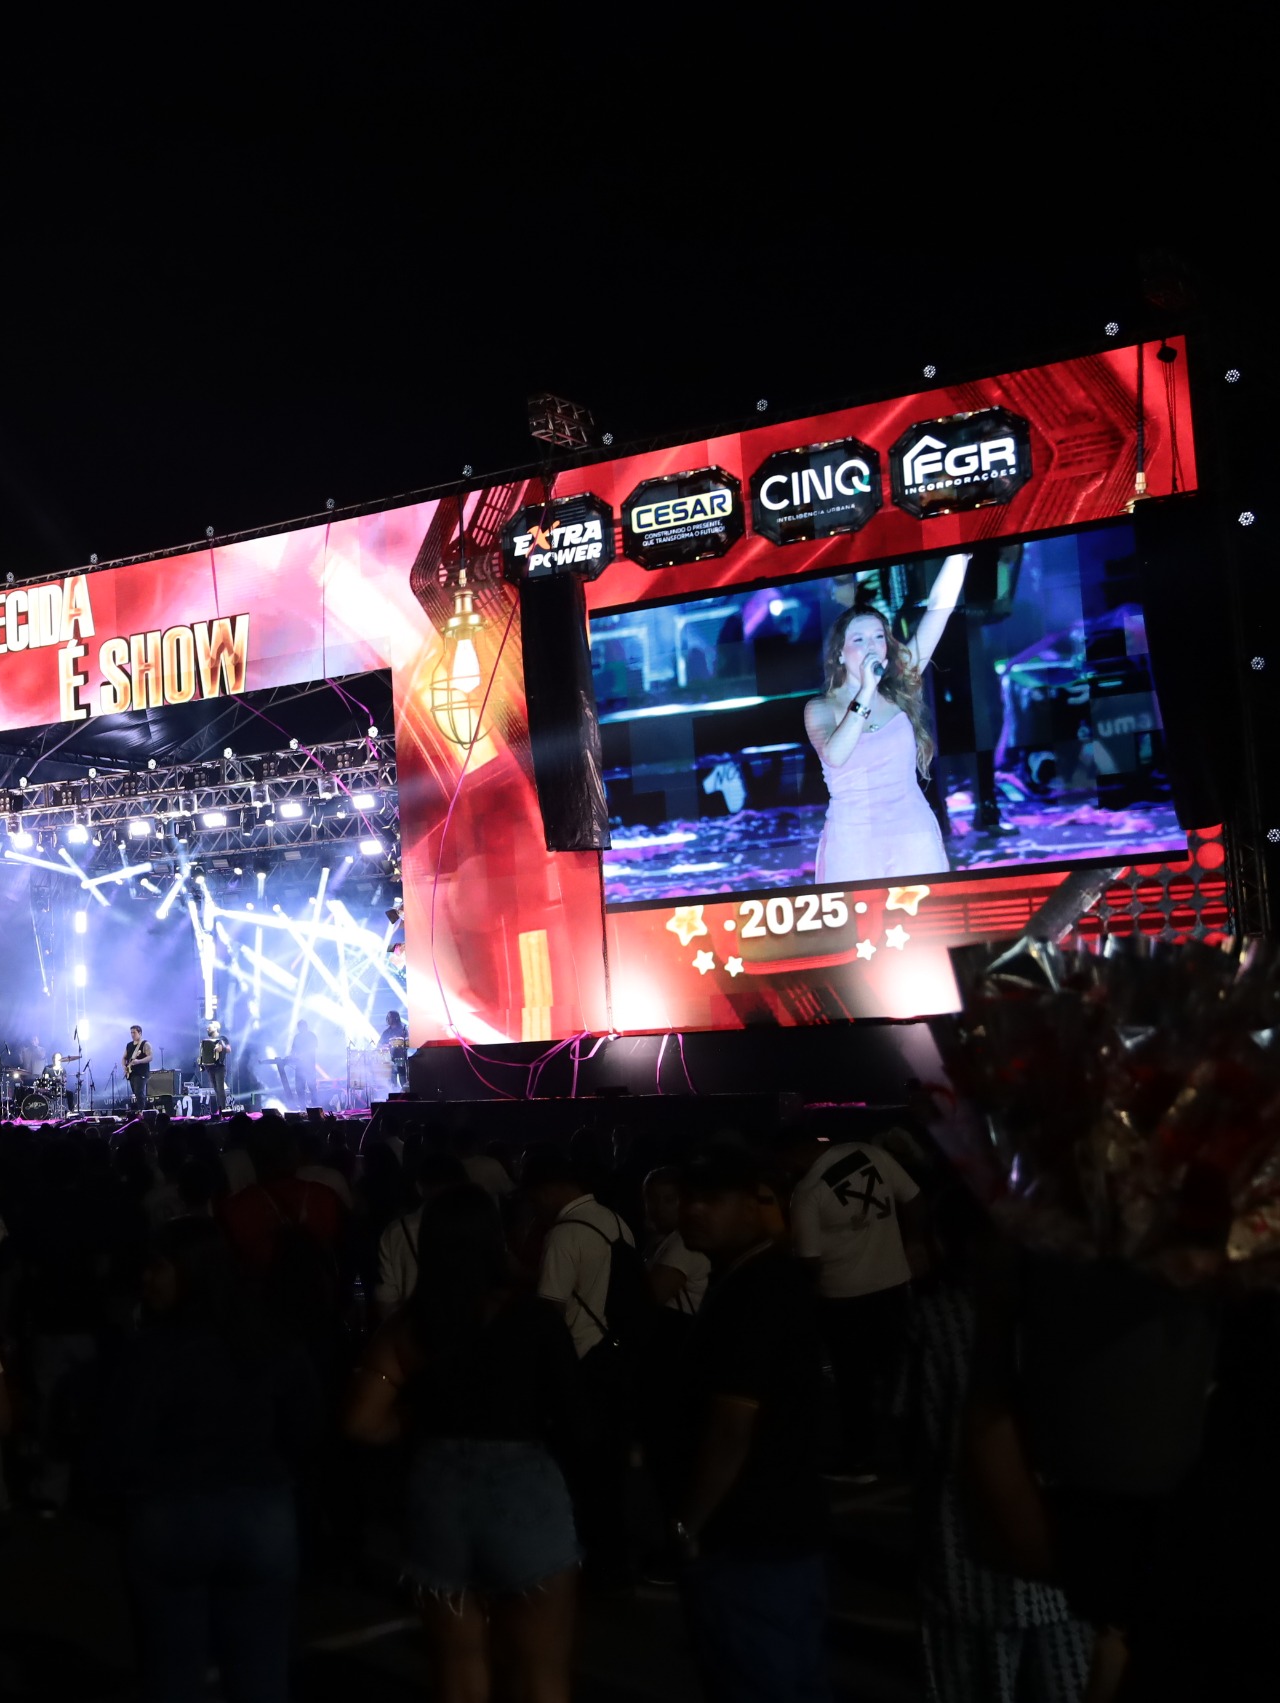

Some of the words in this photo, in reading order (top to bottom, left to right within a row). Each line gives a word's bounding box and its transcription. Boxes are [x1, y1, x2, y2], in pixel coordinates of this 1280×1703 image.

[913, 437, 1017, 485] FGR
[760, 459, 872, 511] CINQ
[904, 467, 1018, 496] INCORPORAÇÕES
[636, 494, 728, 530] CESAR
[513, 520, 603, 558] EXTRA
[528, 542, 603, 571] POWER
[642, 538, 655, 547] QUE
[655, 531, 694, 544] TRANSFORMA
[694, 529, 700, 537] O
[58, 638, 92, 722] É
[99, 612, 251, 715] SHOW
[739, 892, 849, 939] 2025
